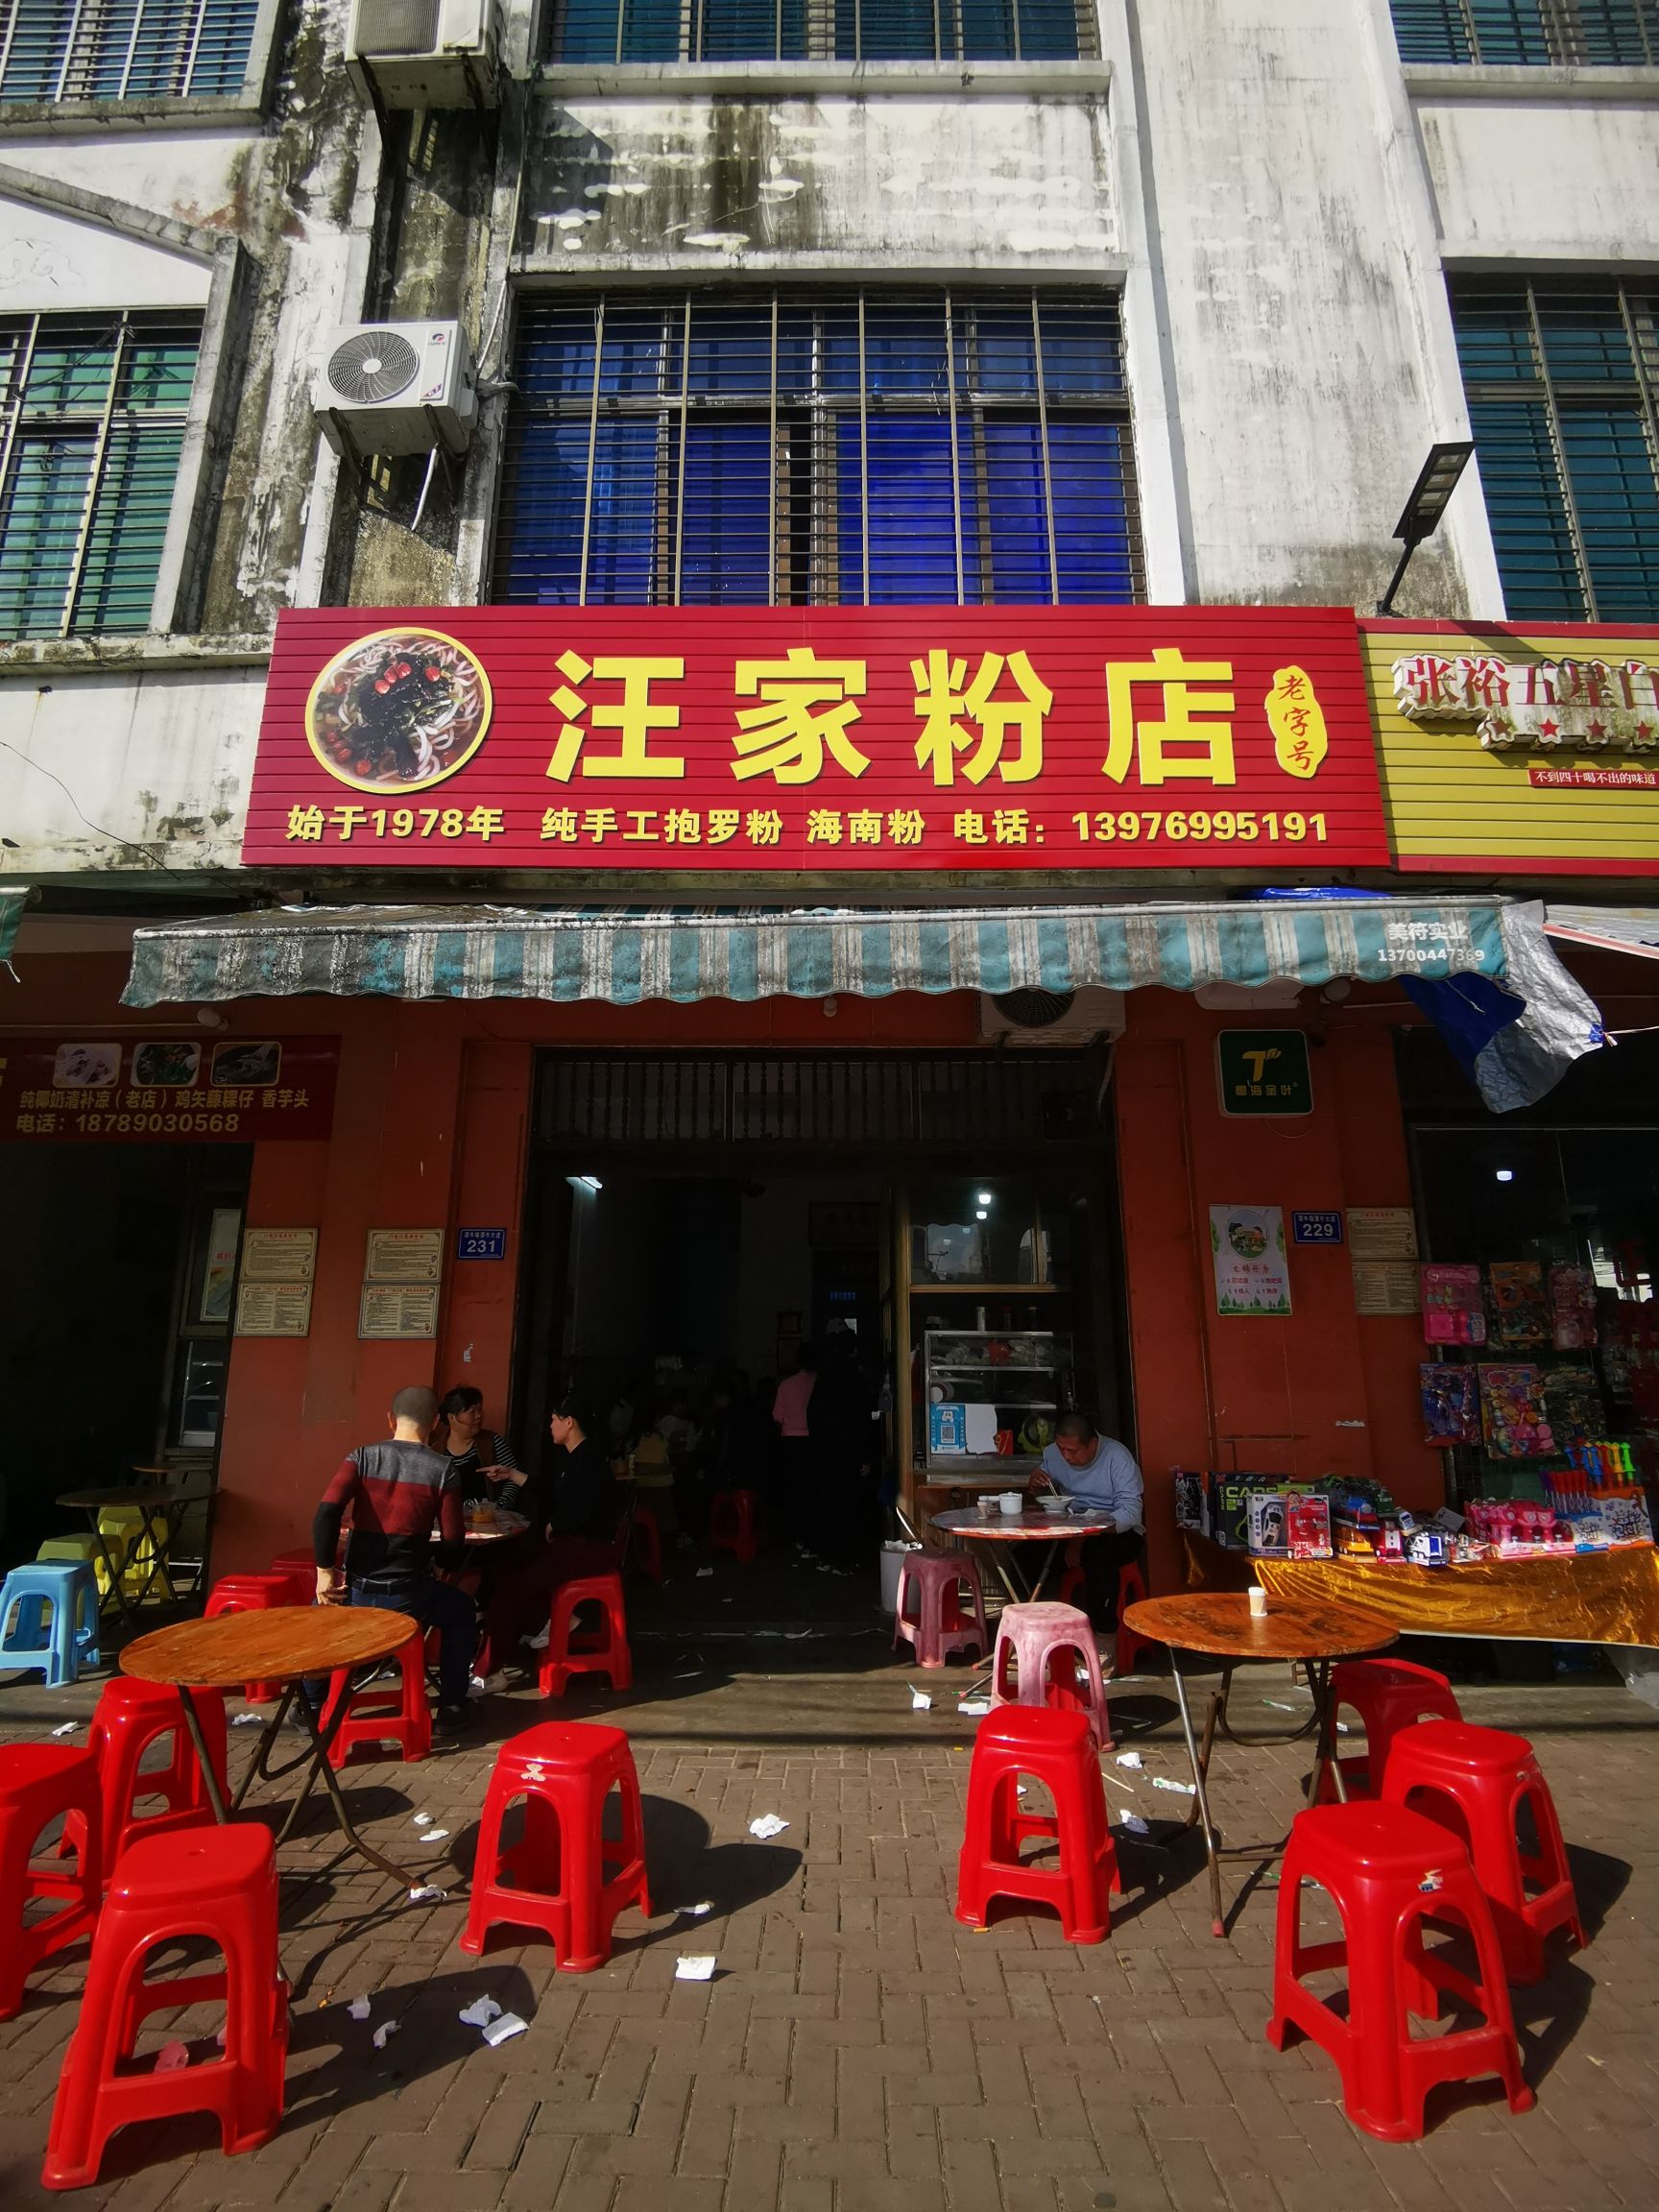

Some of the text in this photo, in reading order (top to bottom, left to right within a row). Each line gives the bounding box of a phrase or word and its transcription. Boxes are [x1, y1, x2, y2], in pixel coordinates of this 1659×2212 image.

[546, 646, 1238, 786] 汪家粉店
[1277, 673, 1313, 771] 老字号
[1536, 770, 1656, 785] 不到四十喝不出的味道
[286, 804, 505, 842] 始于1978年
[541, 806, 783, 845] 纯手工抱罗粉
[806, 808, 926, 845] 海南粉
[1071, 809, 1329, 842] 13976995191
[1387, 920, 1469, 942] 美符实业
[1302, 1223, 1334, 1238] 229
[467, 1239, 496, 1254] 231
